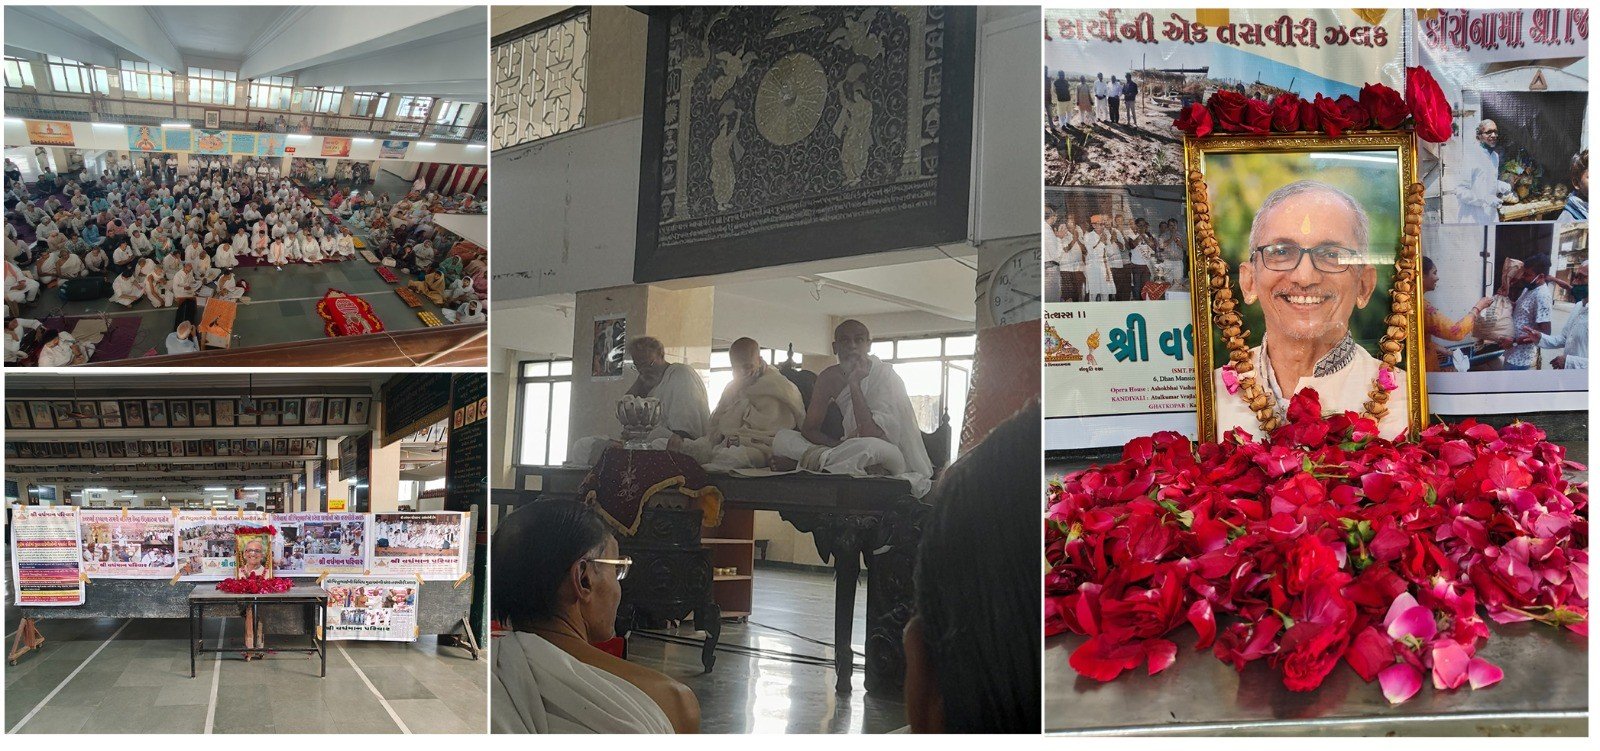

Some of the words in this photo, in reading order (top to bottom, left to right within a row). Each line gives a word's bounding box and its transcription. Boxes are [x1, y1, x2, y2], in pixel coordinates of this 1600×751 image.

[1162, 12, 1208, 45] એક
[1216, 15, 1320, 49] તસવીરી
[1324, 24, 1388, 48] ઝલક
[1013, 258, 1022, 268] 11
[1000, 274, 1009, 286] 10
[994, 296, 1001, 307] 9
[1106, 312, 1150, 363] શ્રી
